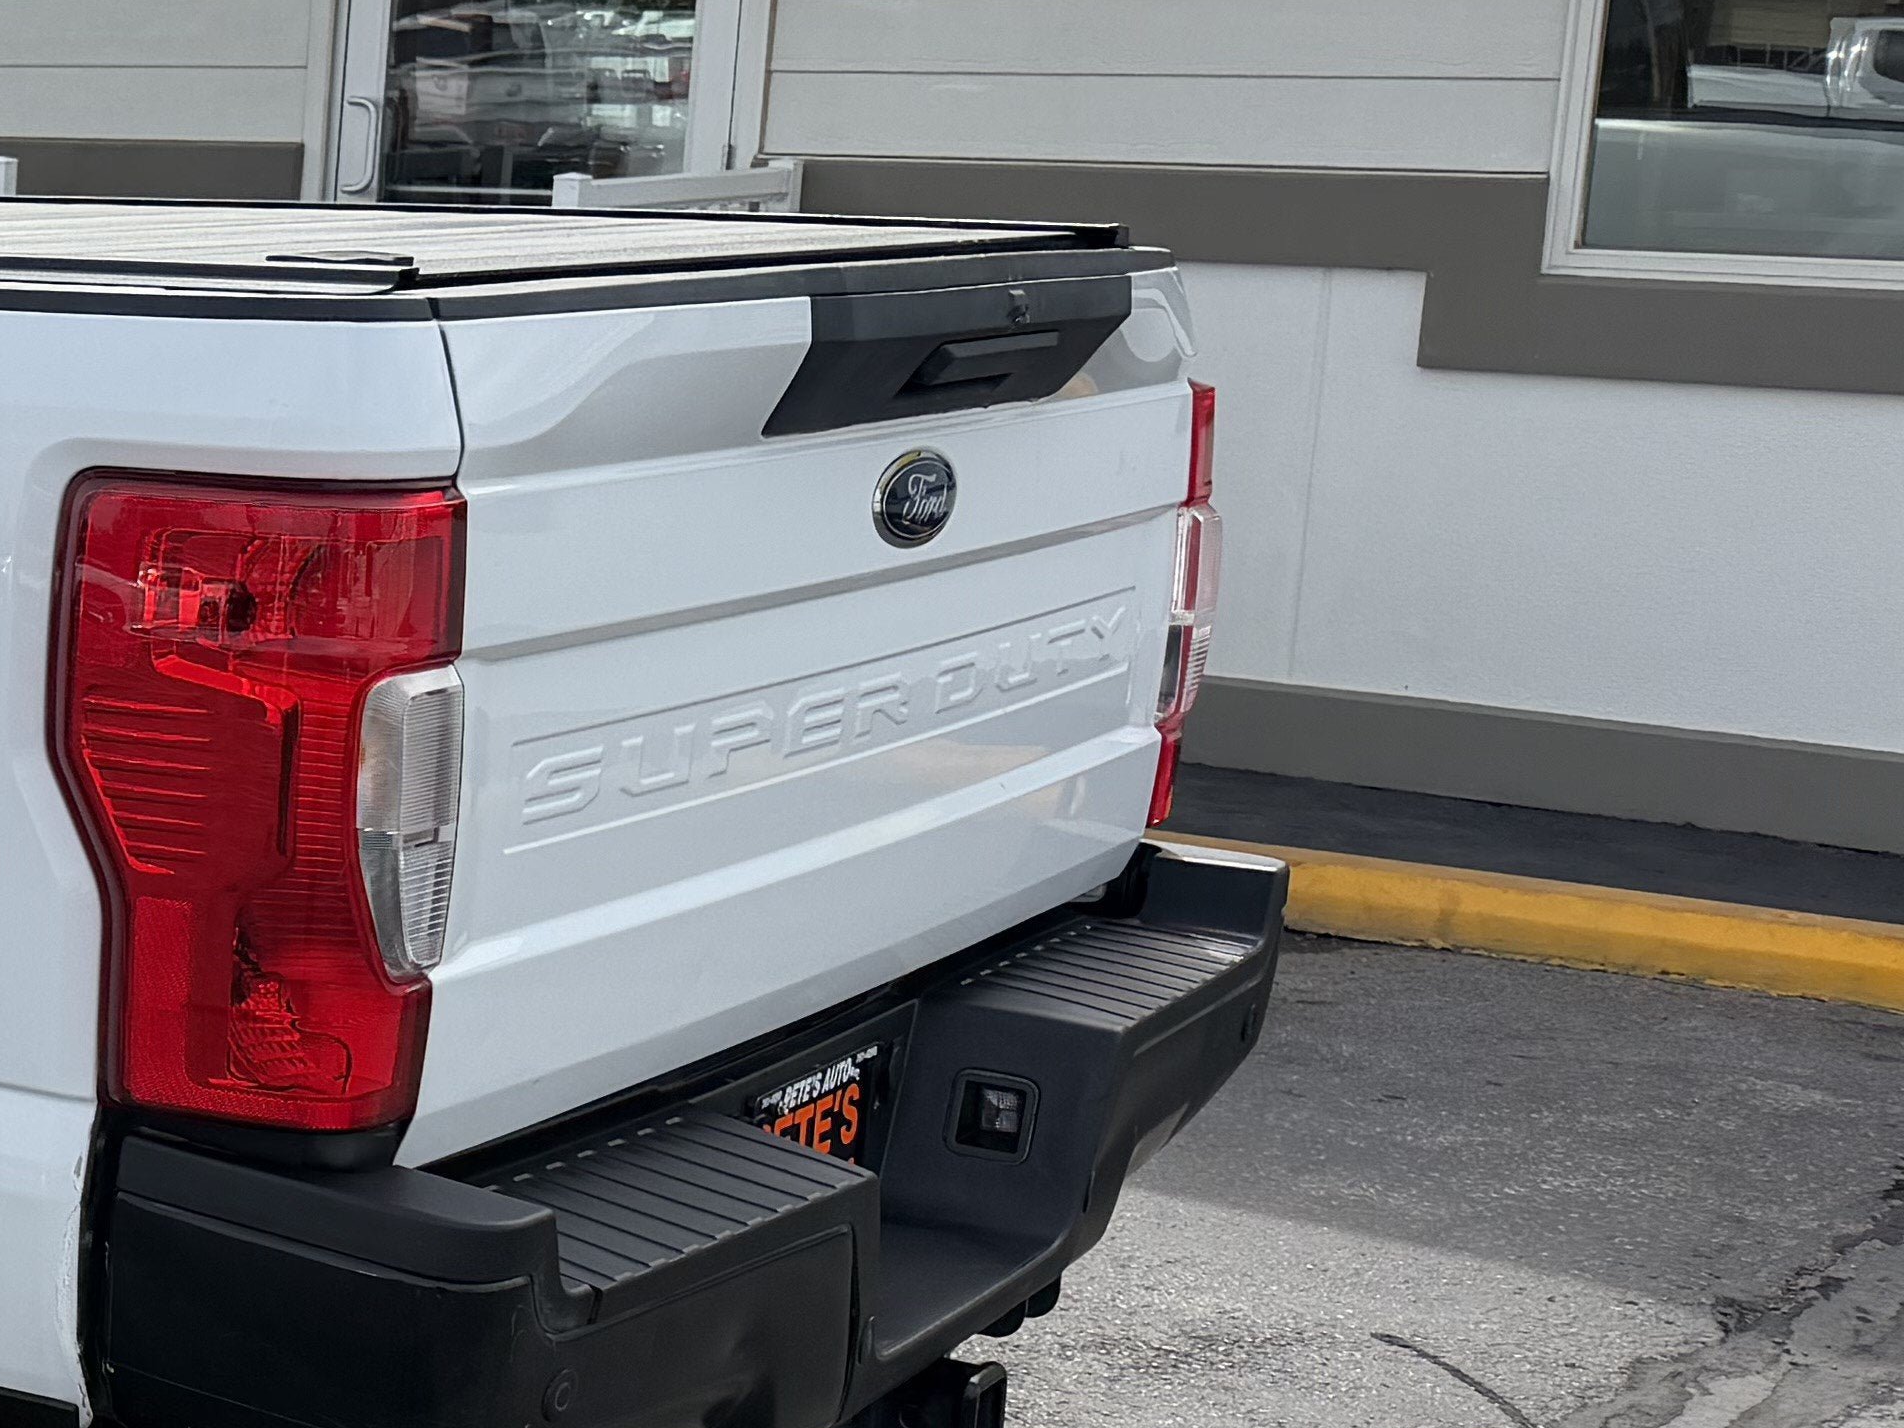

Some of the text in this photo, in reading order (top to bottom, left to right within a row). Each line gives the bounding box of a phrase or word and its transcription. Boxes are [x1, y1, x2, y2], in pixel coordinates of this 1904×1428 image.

[901, 473, 949, 526] Ford
[520, 603, 1130, 827] SUPER DUTY
[762, 1083, 860, 1155] ETE'S
